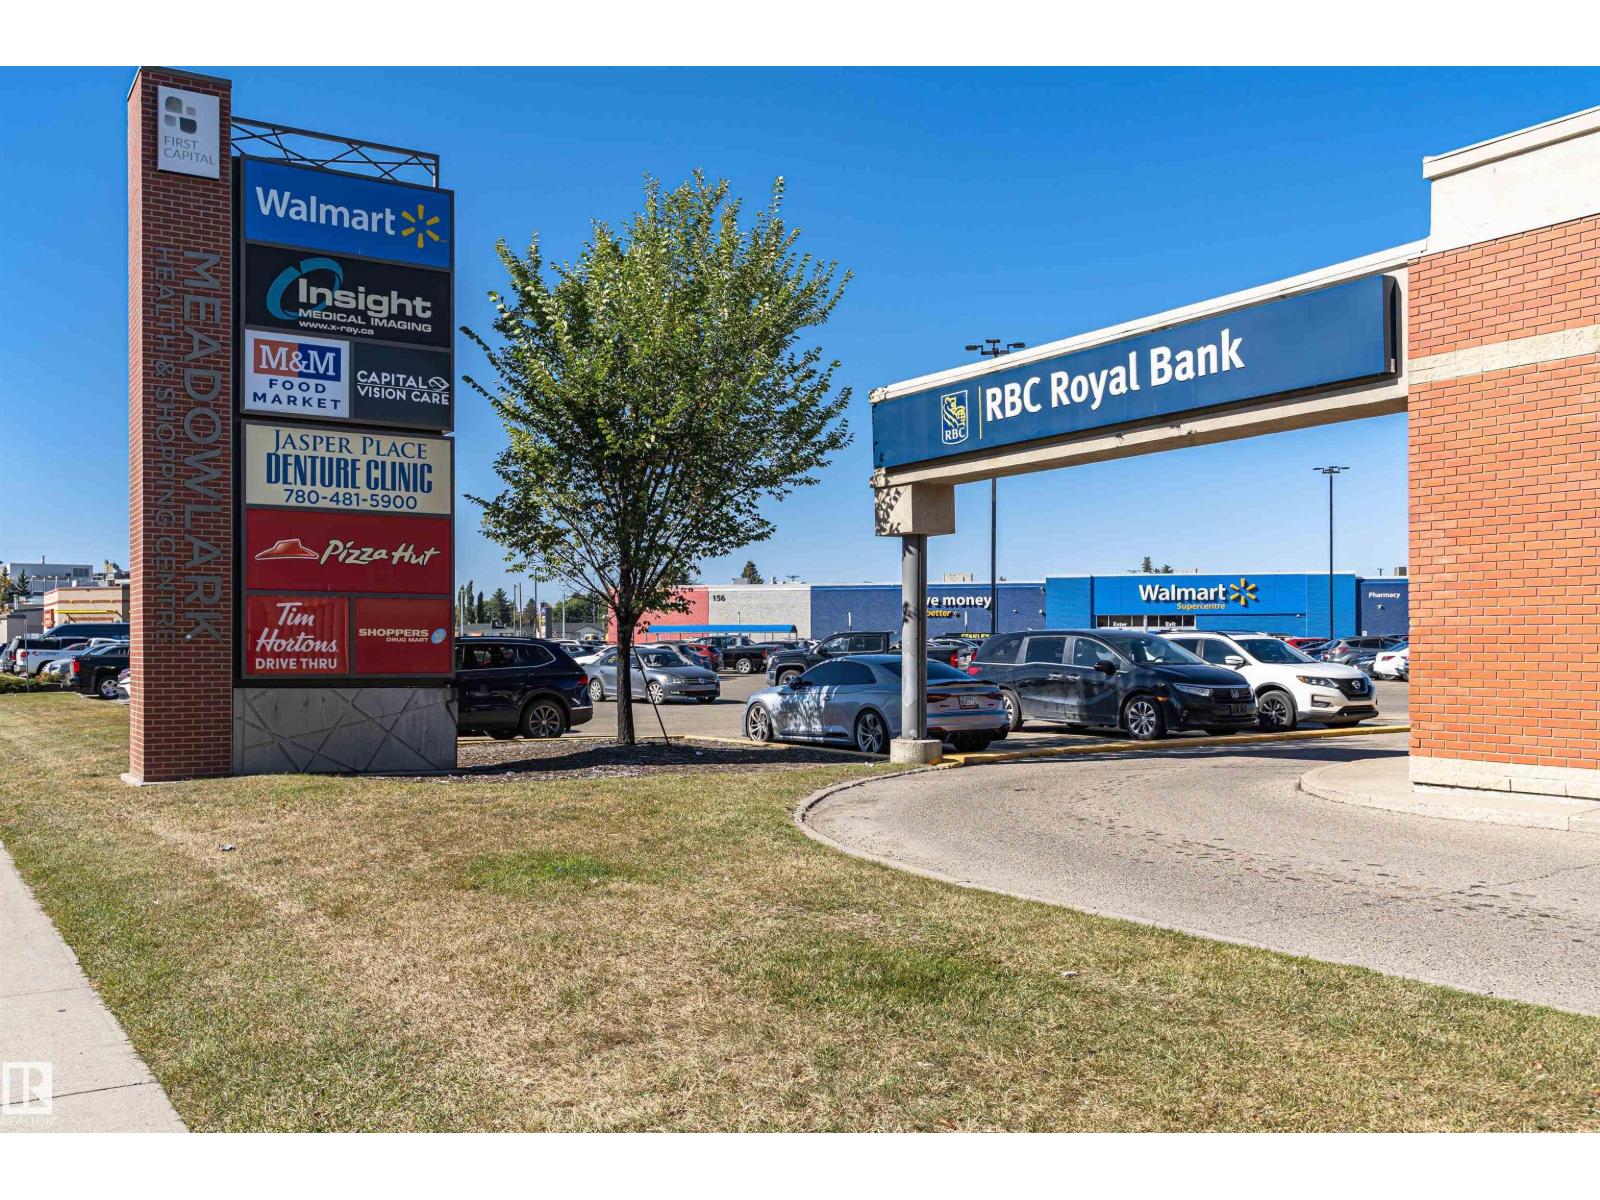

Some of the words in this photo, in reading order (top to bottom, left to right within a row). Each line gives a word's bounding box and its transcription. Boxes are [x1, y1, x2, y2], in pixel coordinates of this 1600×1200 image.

[164, 135, 199, 150] FIRST
[163, 148, 216, 166] CAPITAL
[256, 187, 396, 236] Walmart
[155, 248, 176, 351] HEALTH
[298, 278, 432, 319] Insight
[298, 308, 367, 325] MEDICAL
[370, 316, 432, 333] IMAGING
[298, 320, 375, 336] www.x-ray.ca
[155, 360, 176, 378] &
[259, 344, 337, 377] M&M
[268, 378, 327, 394] FOOD
[356, 370, 428, 389] CAPITAL
[985, 377, 1043, 422] RBC
[1050, 350, 1141, 411] Royal
[1150, 328, 1246, 387] Bank
[252, 391, 341, 410] MARKET
[356, 384, 407, 401] VISION
[411, 391, 450, 406] CARE
[273, 429, 353, 455] JASPER
[362, 436, 428, 460] PLACE
[945, 426, 966, 441] RBC
[155, 387, 176, 527] SHOPPING
[183, 251, 223, 643] MEADOWLARK
[266, 452, 361, 490] DENTURE
[366, 459, 433, 494] CLINIC
[283, 488, 418, 510] 780-481-5900
[319, 539, 389, 566] Pizza
[391, 542, 441, 566] Hut
[155, 536, 176, 645] CENTRE
[712, 594, 726, 602] 156
[1138, 583, 1226, 601] Walmart
[942, 596, 992, 609] money
[1176, 602, 1226, 611] Supercentre
[276, 602, 315, 626] Tim
[256, 626, 337, 653] Hortons
[358, 628, 429, 638] SHOPPERS
[255, 658, 297, 670] DRIVE
[299, 658, 338, 670] THRU
